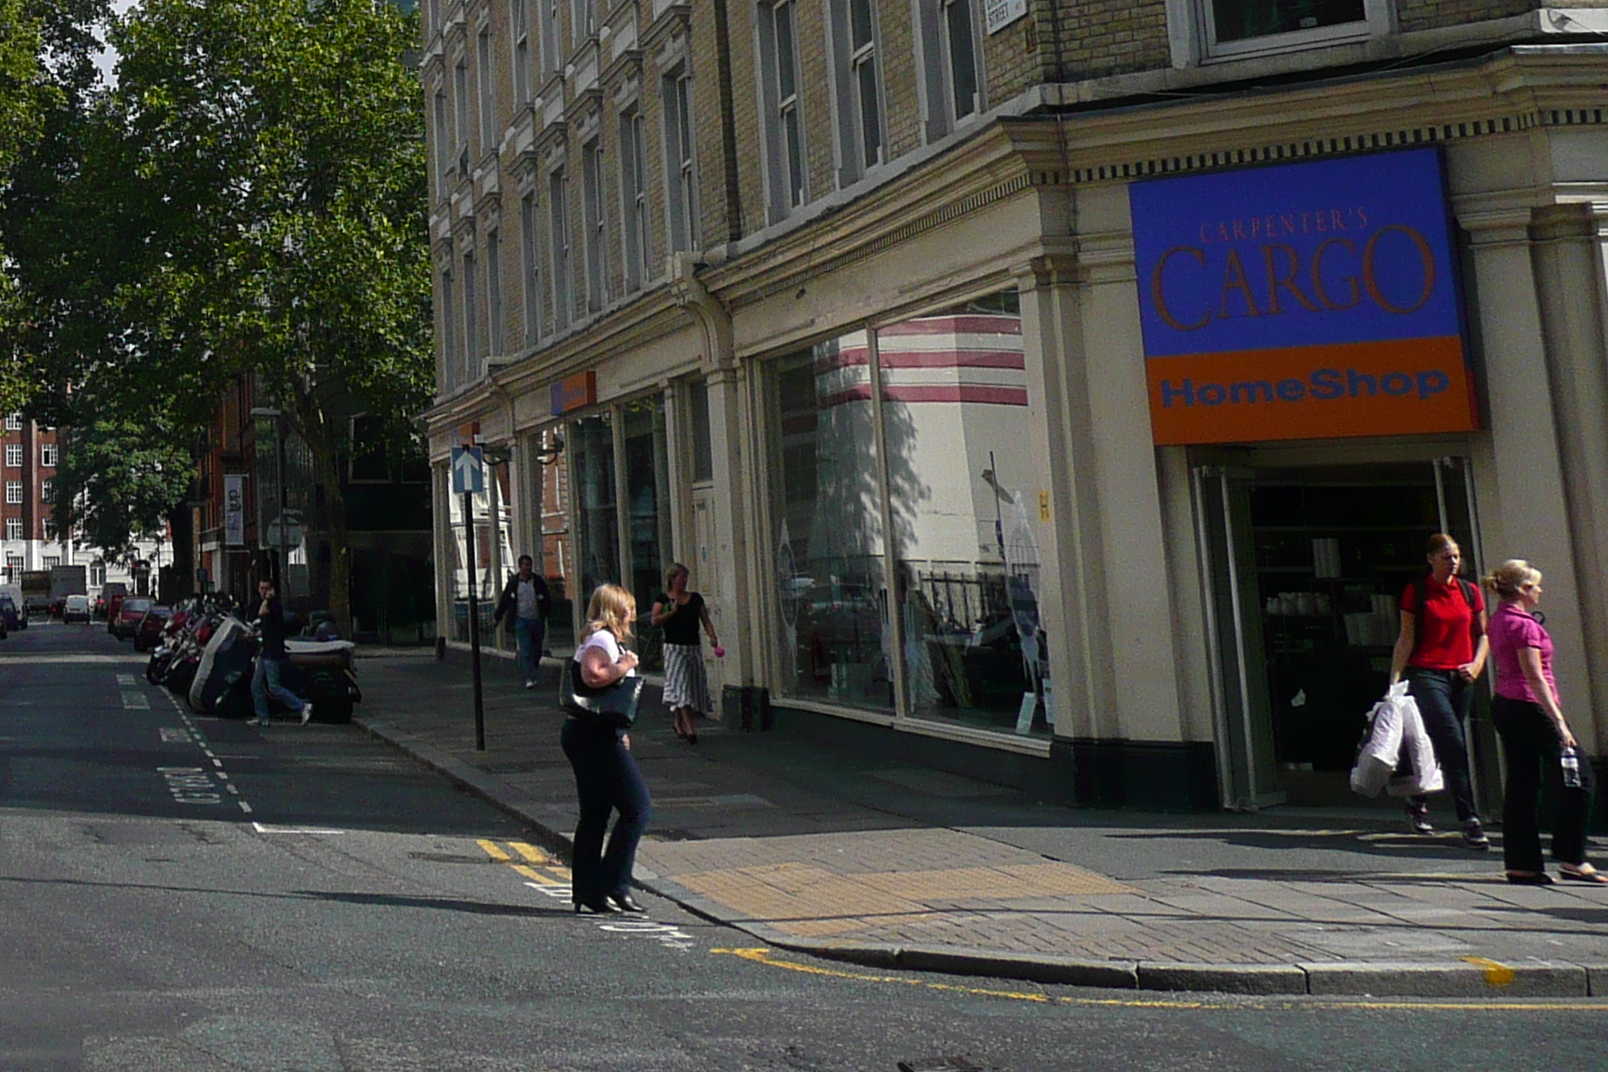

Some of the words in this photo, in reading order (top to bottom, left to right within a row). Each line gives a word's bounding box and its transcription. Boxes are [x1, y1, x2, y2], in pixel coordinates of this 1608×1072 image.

[1199, 206, 1370, 243] CARPENTER'S
[1151, 224, 1436, 331] CARGO
[1160, 368, 1451, 409] HomeShop
